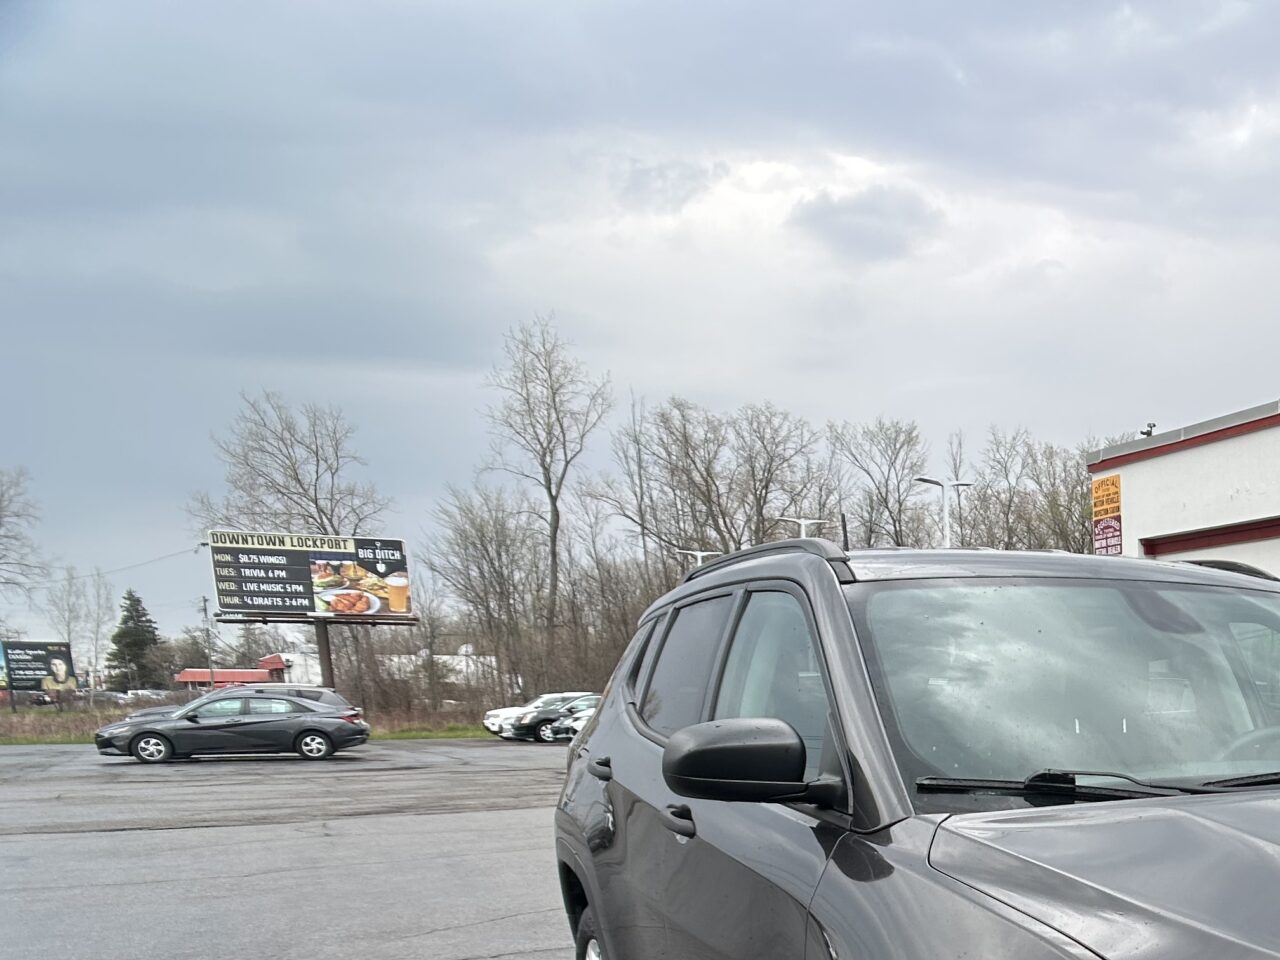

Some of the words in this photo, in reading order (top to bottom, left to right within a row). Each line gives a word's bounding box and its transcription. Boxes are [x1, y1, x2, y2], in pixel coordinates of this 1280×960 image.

[1095, 480, 1119, 493] OFFICIAL
[211, 533, 286, 547] DOWNTOWN
[290, 537, 348, 550] LOCKPORT
[358, 549, 374, 558] BIG
[375, 550, 401, 559] DITCH
[216, 567, 237, 576] TUES:
[240, 568, 266, 577] TRIVIA
[274, 570, 286, 578] PM
[217, 582, 238, 590] WED:
[242, 583, 260, 591] LIVE
[260, 584, 284, 592] MUSIC
[219, 596, 242, 604] THUR:
[253, 597, 282, 605] DRAFTS
